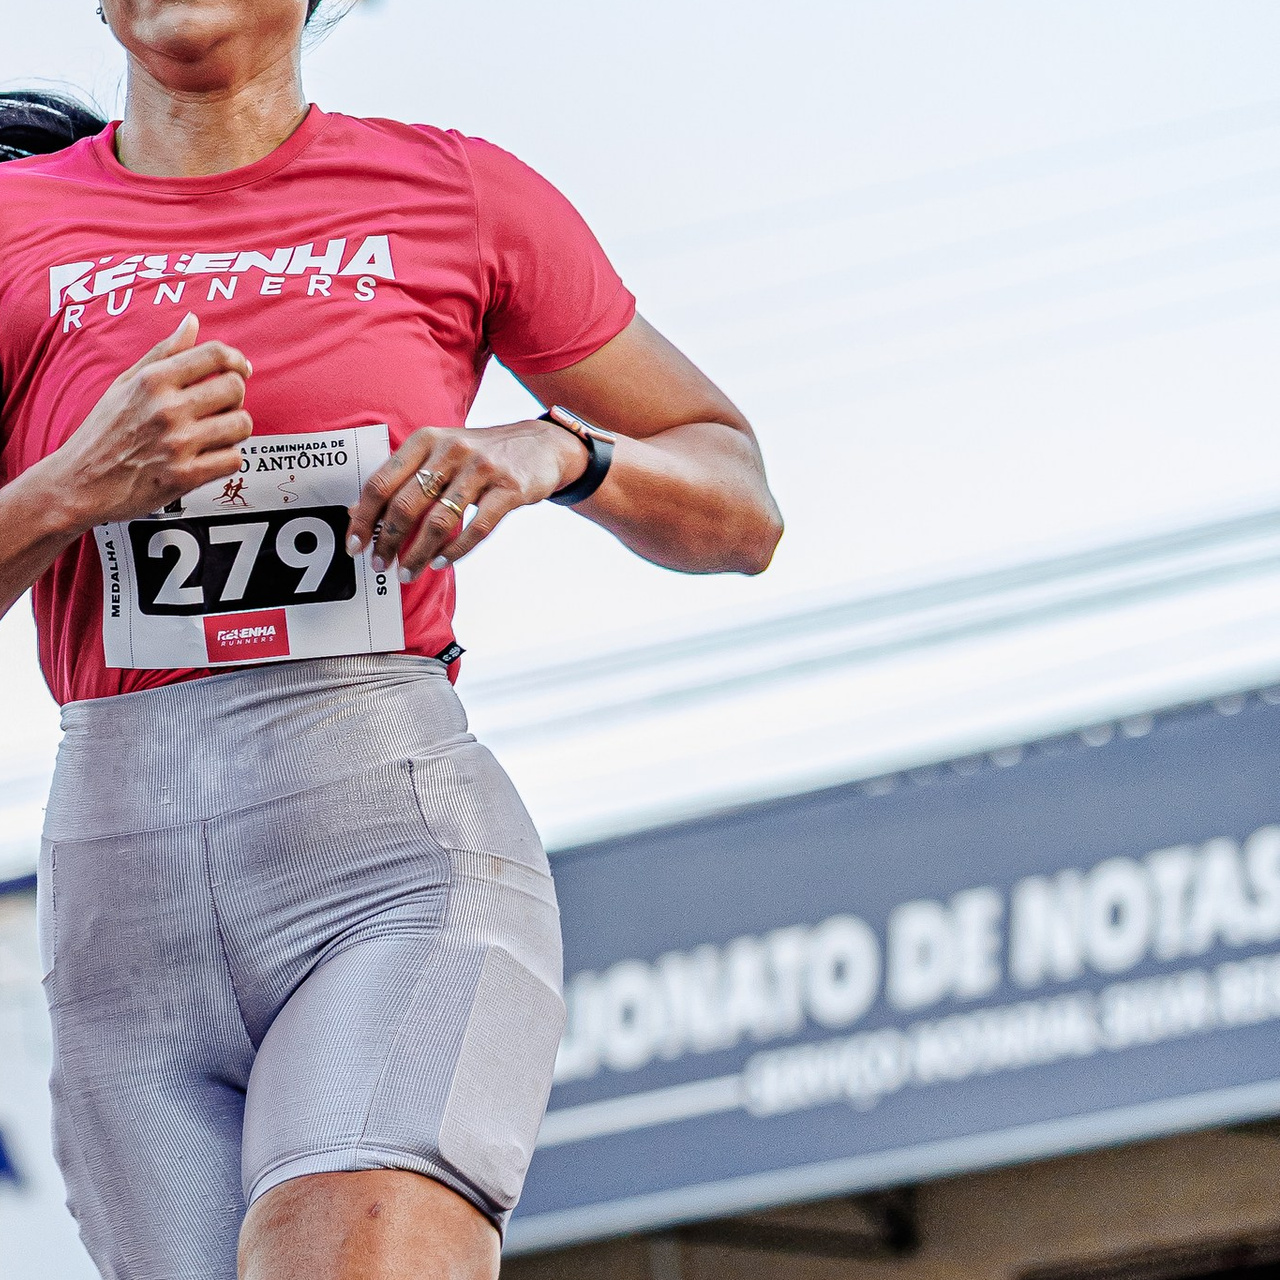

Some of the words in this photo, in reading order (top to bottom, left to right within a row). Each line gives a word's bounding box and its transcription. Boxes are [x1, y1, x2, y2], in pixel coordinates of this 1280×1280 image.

[63, 275, 377, 333] RUNNERS
[250, 447, 258, 455] E
[261, 441, 327, 454] CAMINHADA
[331, 439, 345, 448] DE
[256, 451, 348, 472] ANTÔNIO
[105, 540, 120, 617] MEDALHA
[148, 517, 335, 605] 279
[221, 636, 274, 647] RUNNERS
[887, 886, 1003, 1011] DE
